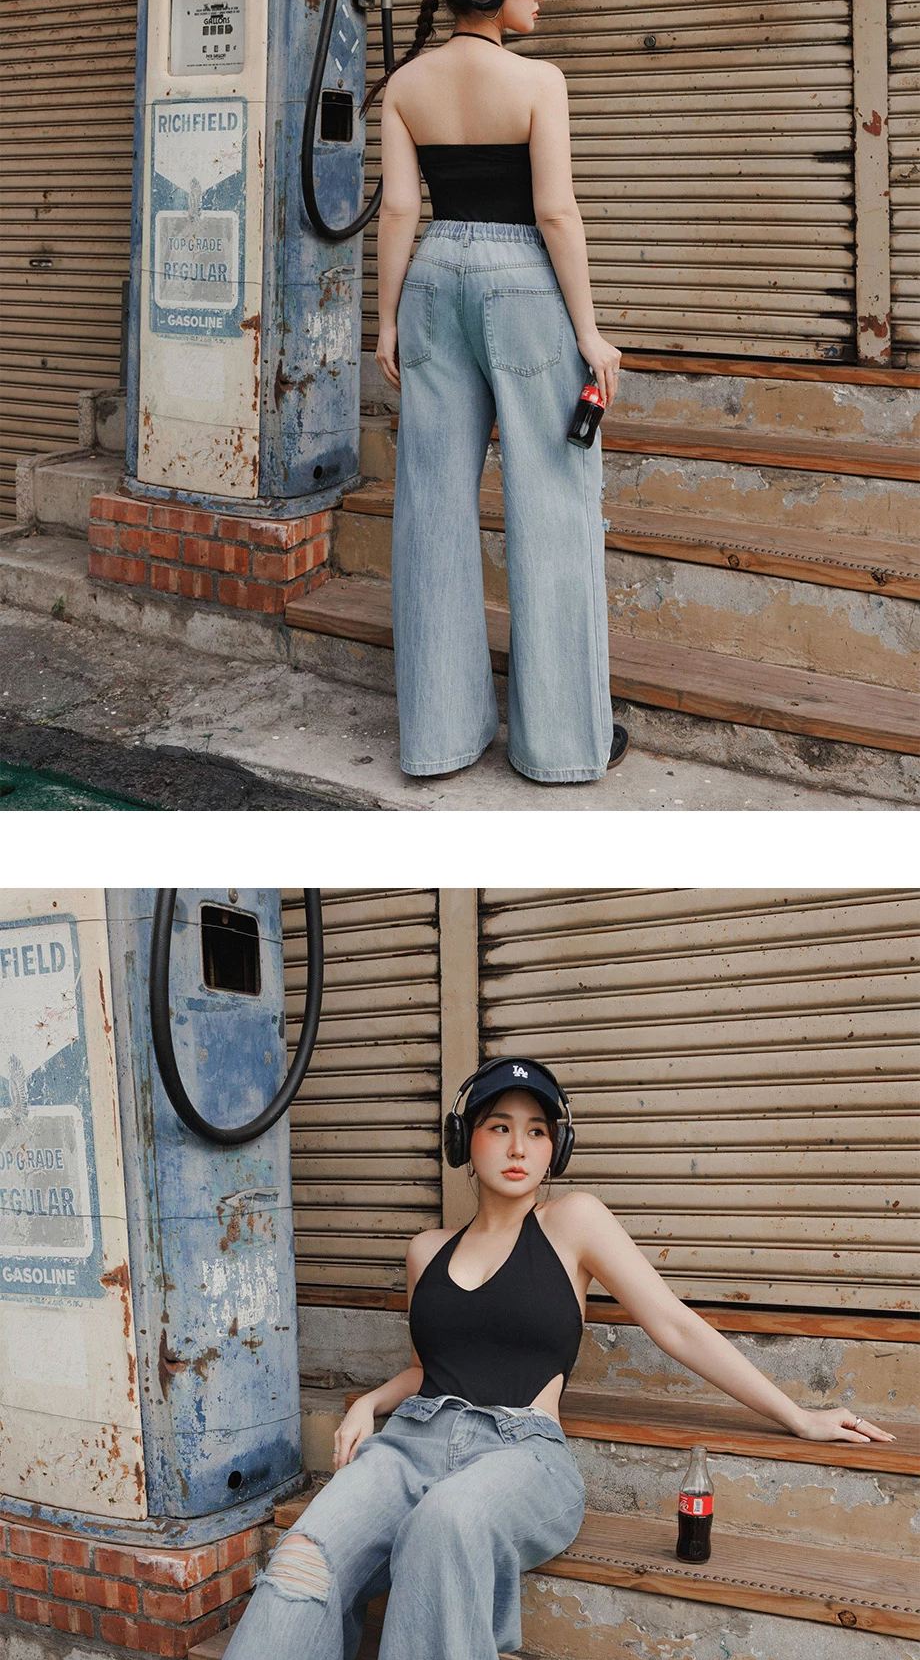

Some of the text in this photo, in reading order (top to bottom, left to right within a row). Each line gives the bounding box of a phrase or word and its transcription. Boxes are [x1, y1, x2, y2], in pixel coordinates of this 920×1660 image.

[203, 16, 231, 25] GALLONS
[158, 112, 239, 133] RICHFIELD
[168, 237, 223, 252] TOP GRADE
[163, 261, 229, 282] REGULAR
[167, 314, 224, 329] GASOLINE
[512, 1065, 529, 1079] LA
[16, 1147, 65, 1171] GRADE
[2, 1267, 77, 1286] GASOLINE
